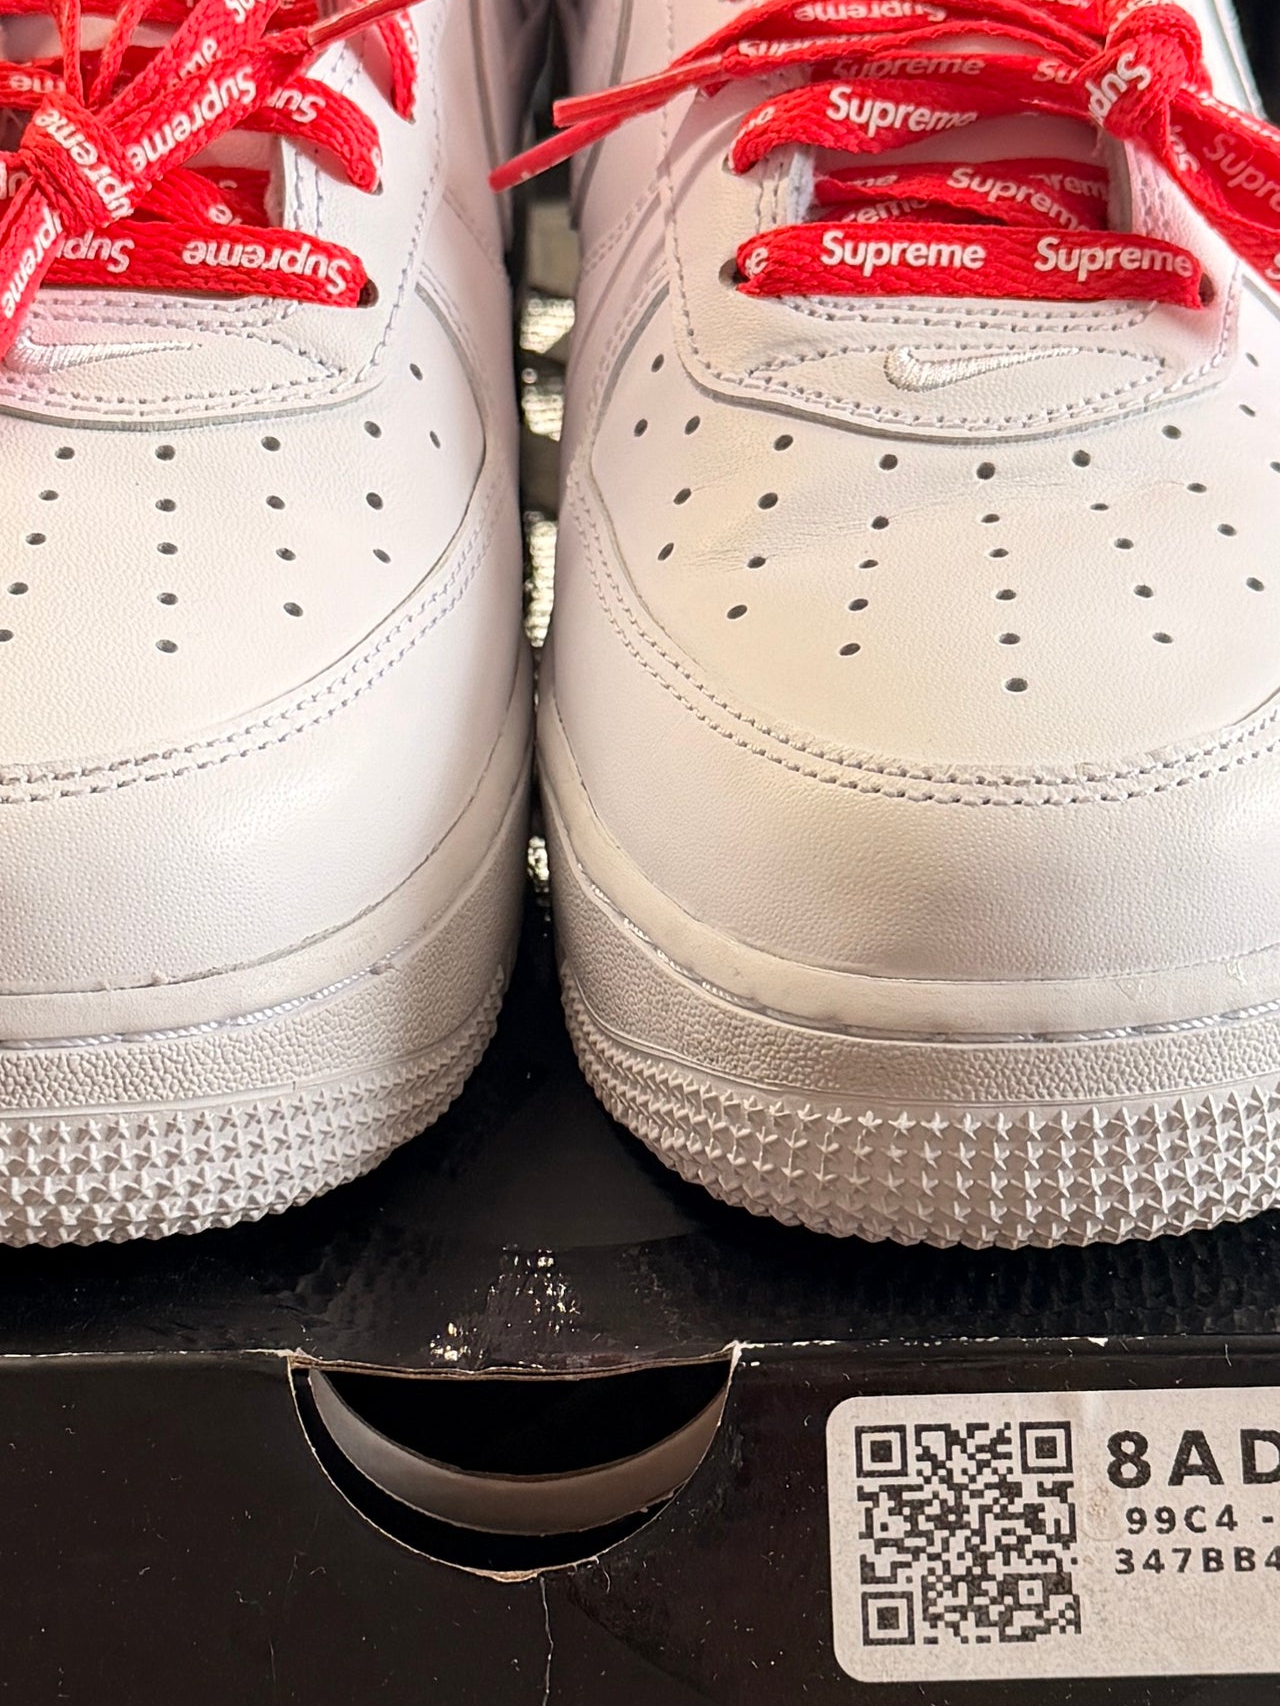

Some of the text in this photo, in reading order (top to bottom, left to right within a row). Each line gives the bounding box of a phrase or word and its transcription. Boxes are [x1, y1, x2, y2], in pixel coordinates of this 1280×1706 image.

[124, 65, 258, 175] Supreme
[825, 85, 979, 139] Supreme
[34, 107, 138, 229] upreme
[946, 165, 1090, 231] Suprem
[0, 201, 63, 320] preme
[181, 239, 352, 296] Supreme
[820, 229, 988, 278] Supreme
[1033, 235, 1194, 283] Supreme
[1125, 1503, 1240, 1536] 99C4
